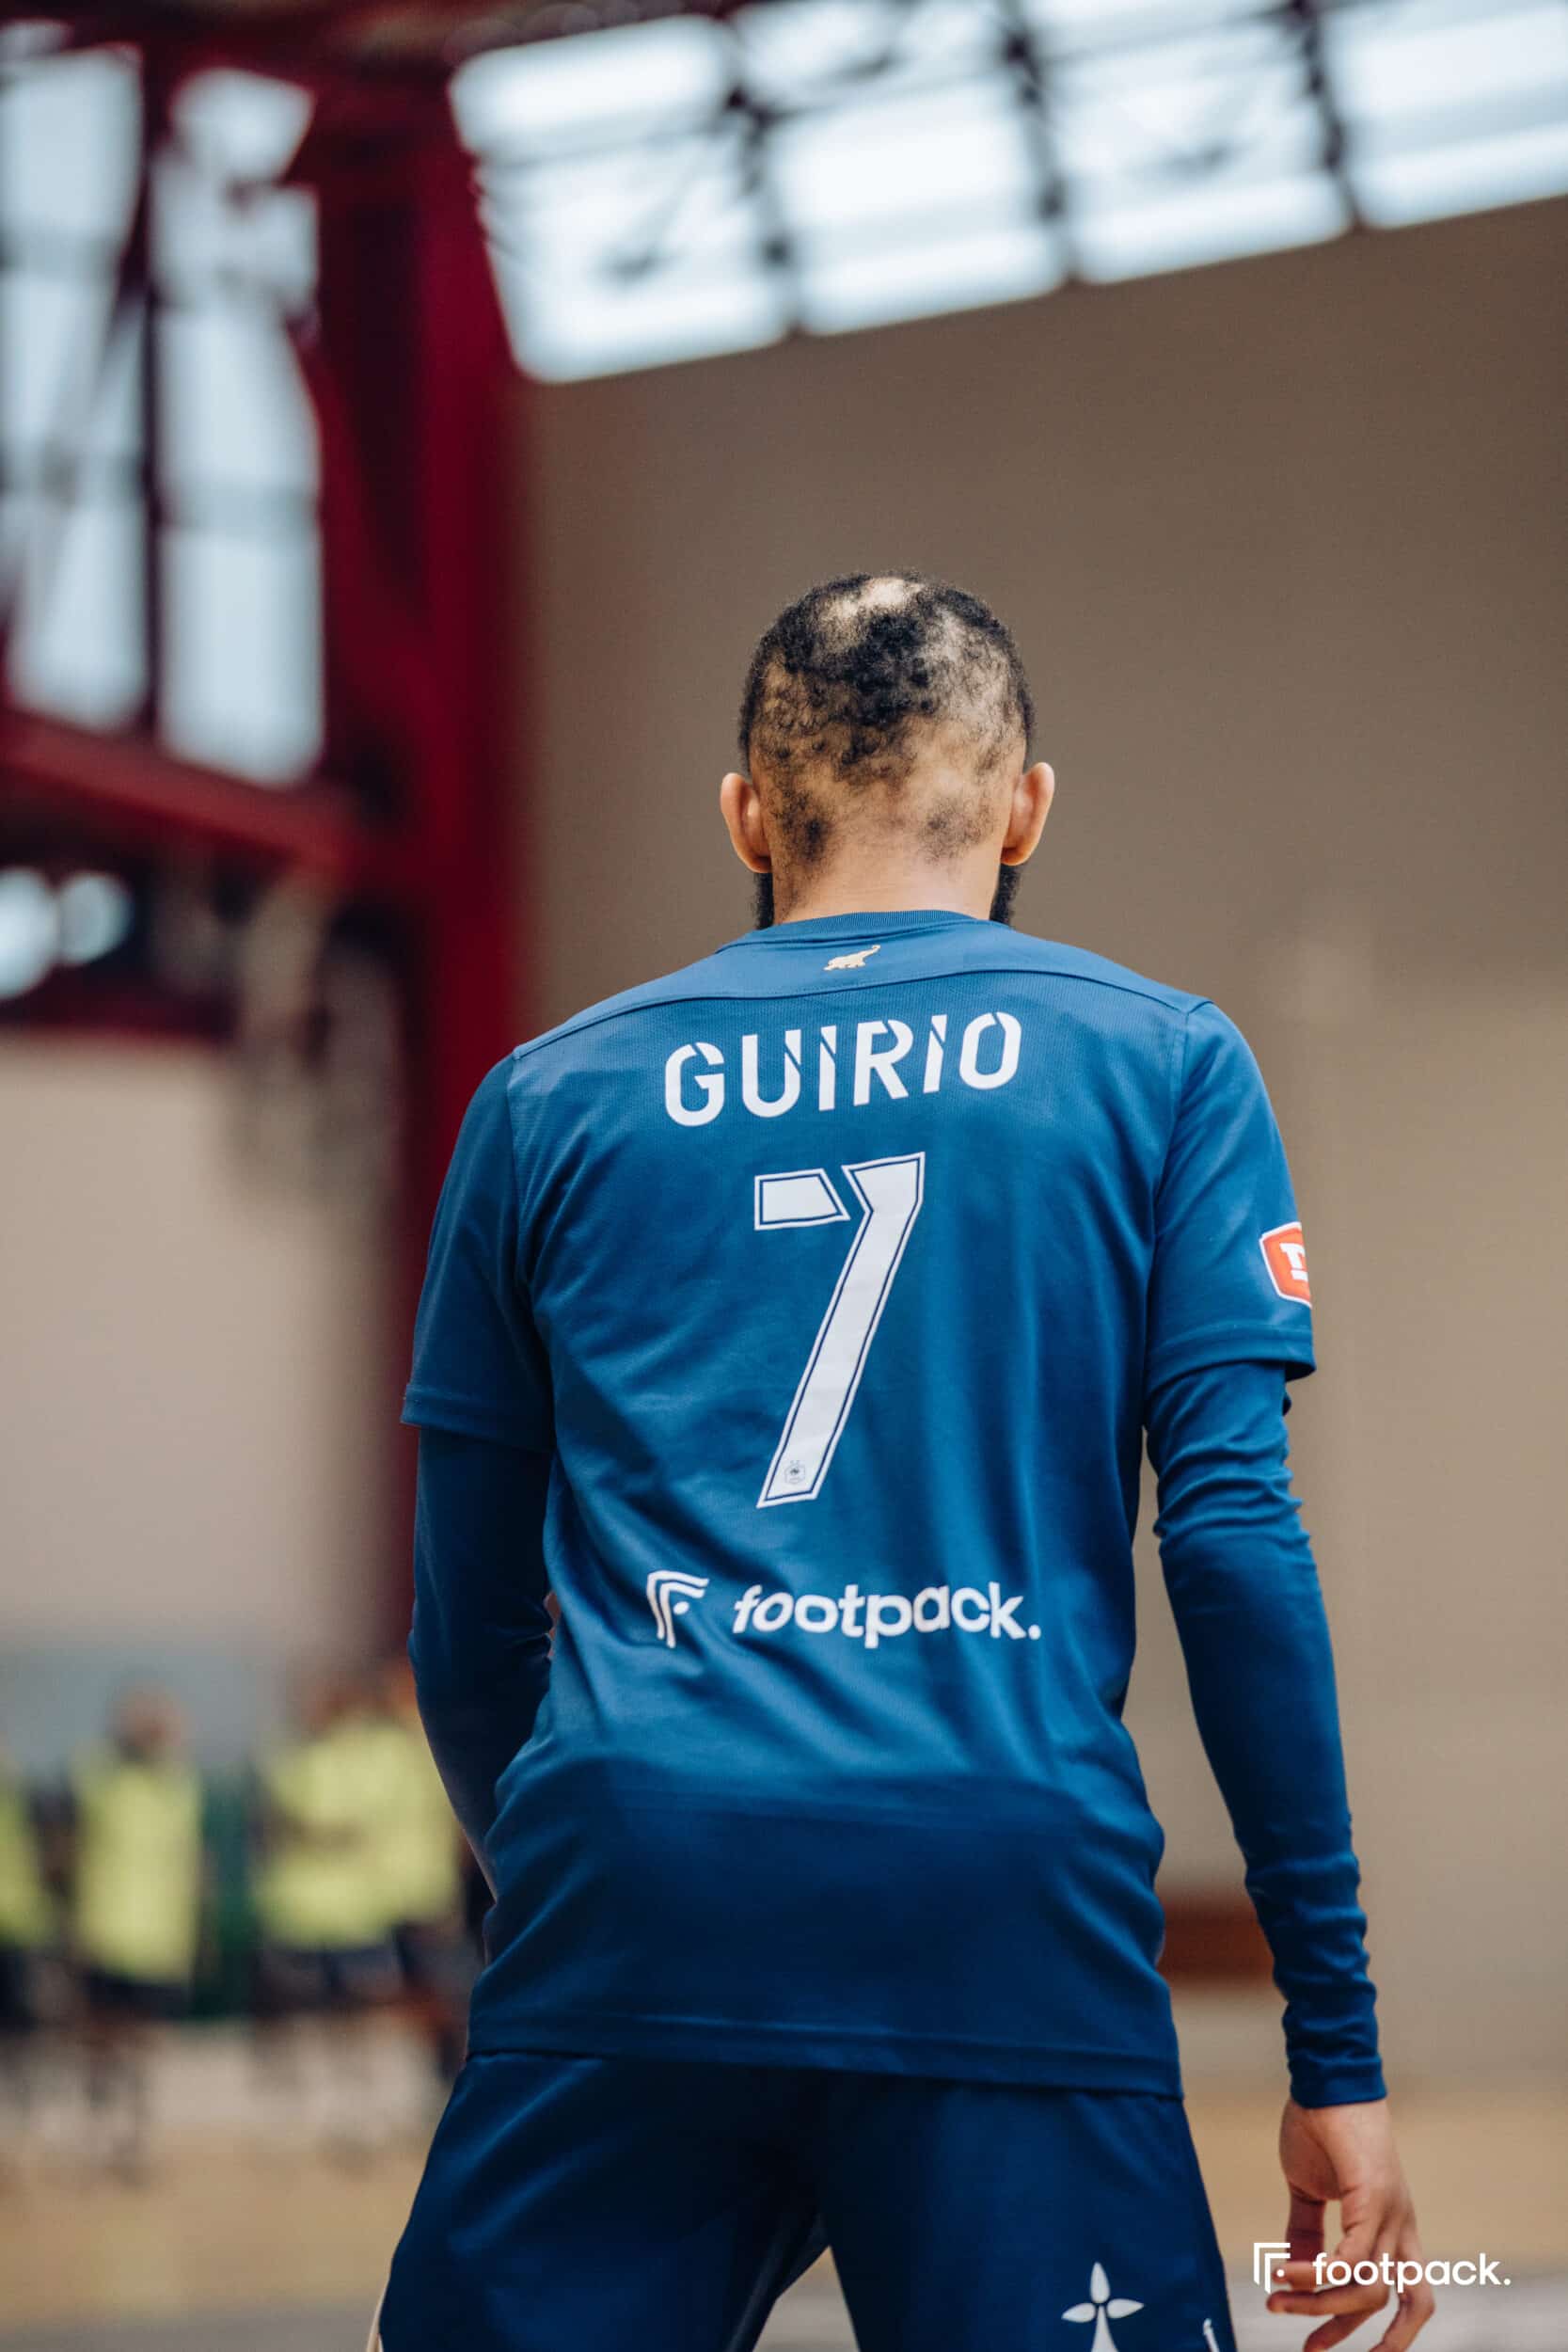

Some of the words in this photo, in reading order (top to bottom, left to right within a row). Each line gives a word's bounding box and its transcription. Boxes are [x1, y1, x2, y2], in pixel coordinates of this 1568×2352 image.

[664, 1011, 1022, 1127] GUIRIO
[753, 1151, 927, 1509] 7
[732, 1581, 1042, 1649] footpack.
